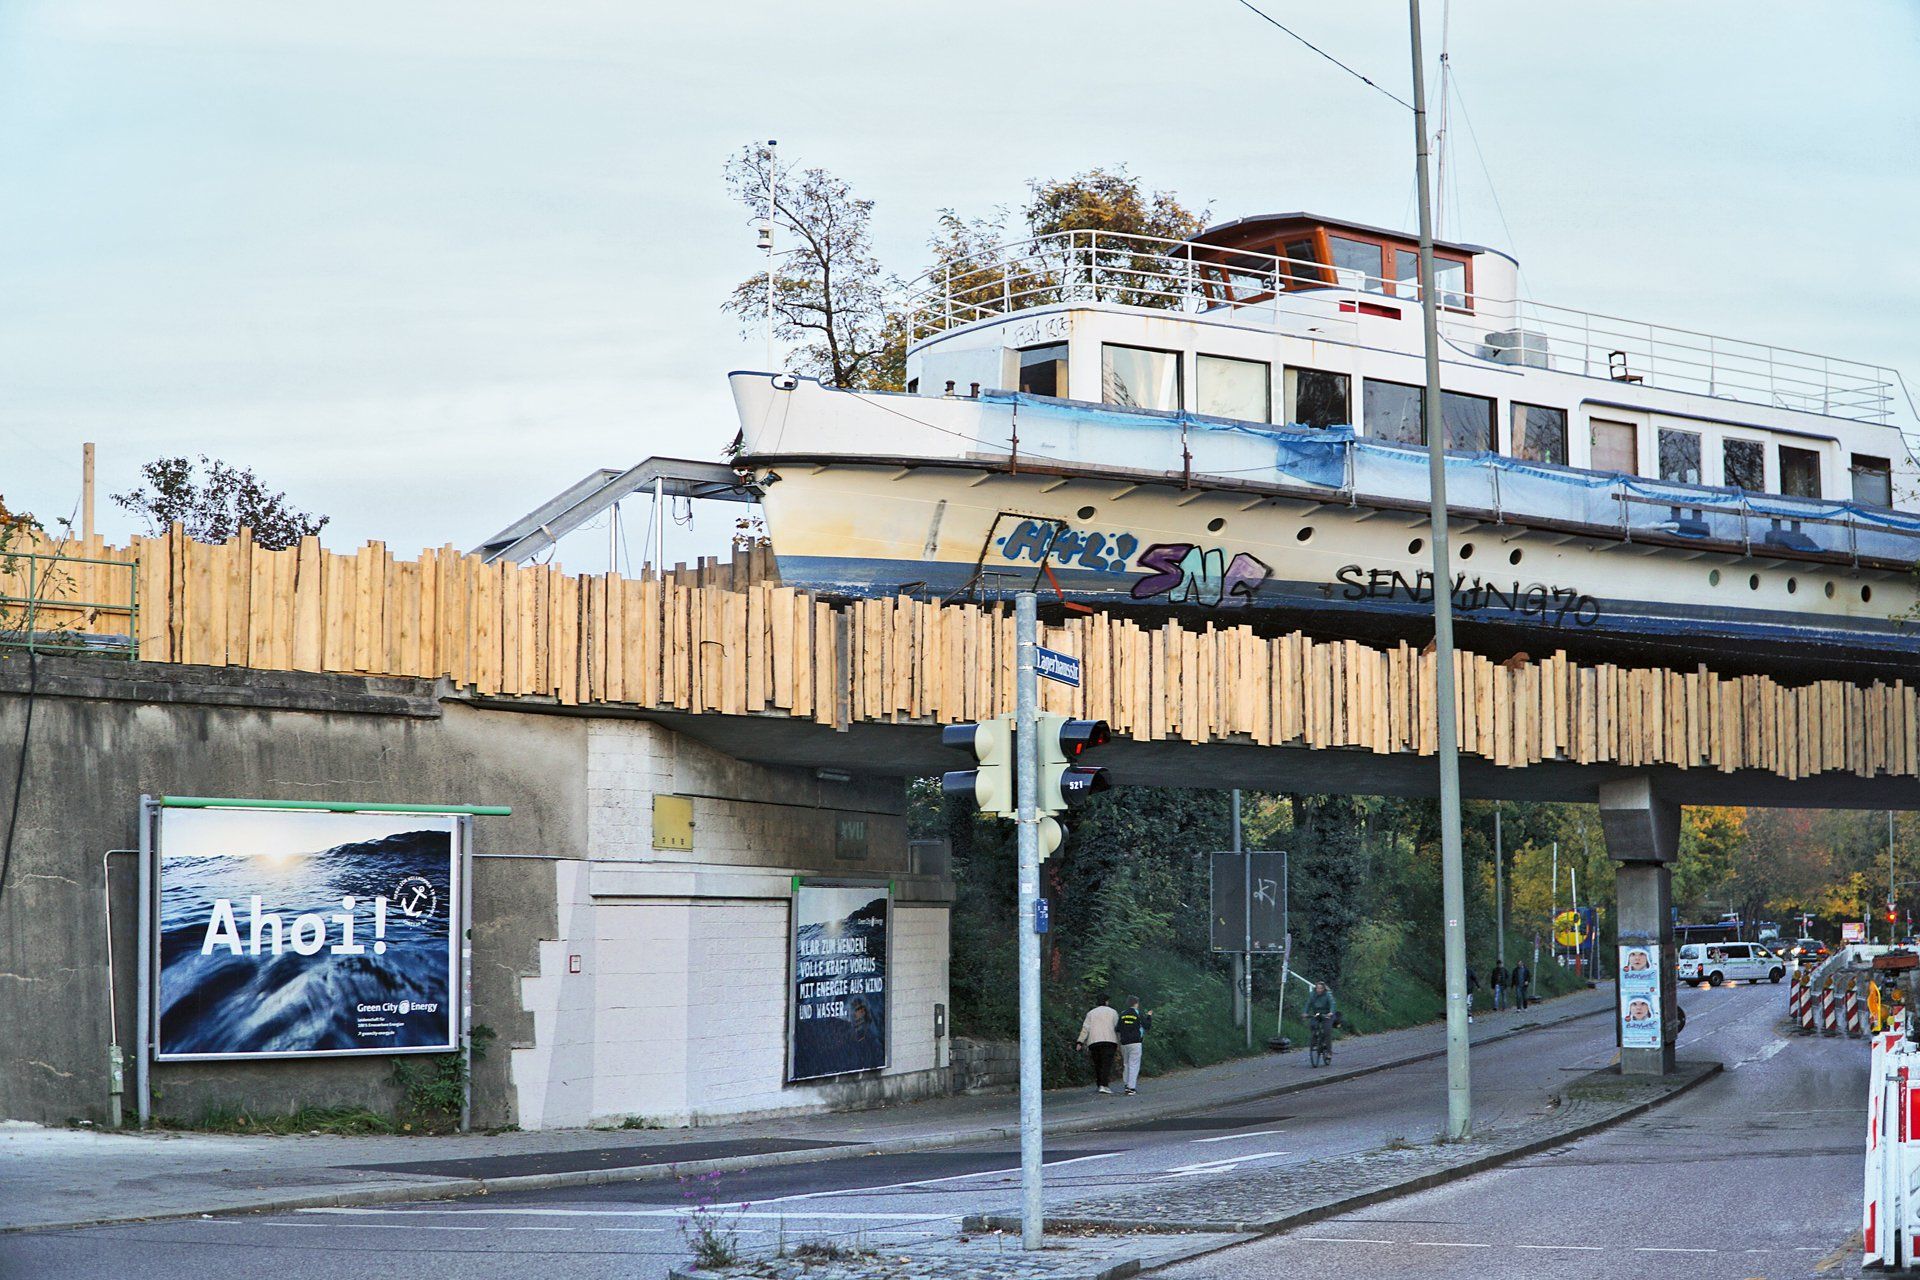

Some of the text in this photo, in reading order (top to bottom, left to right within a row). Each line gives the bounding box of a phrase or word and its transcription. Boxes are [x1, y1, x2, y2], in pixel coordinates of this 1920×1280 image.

[1069, 780, 1083, 790] 521
[201, 894, 387, 956] Ahoi!
[800, 936, 867, 955] KLAR ZUM WENDEN!
[800, 957, 875, 977] VOLLE KRAFT VORAUS
[800, 977, 883, 999] MIT ENERGIE AUS WIND
[357, 1002, 438, 1013] Green City Energy
[799, 1001, 847, 1020] UND WASSER.
